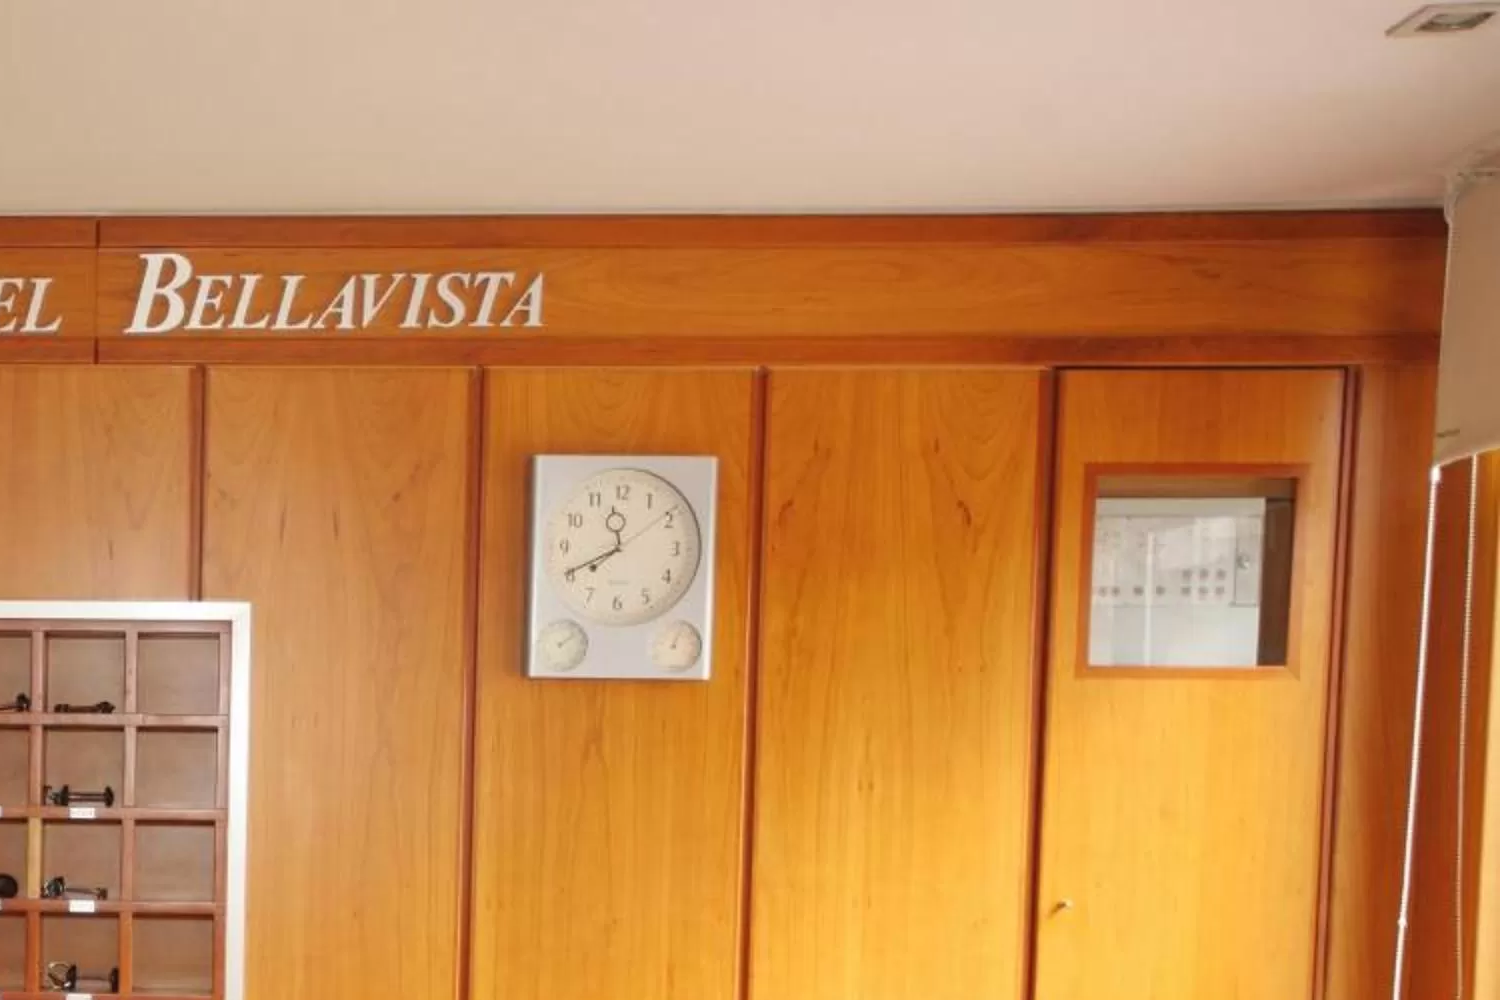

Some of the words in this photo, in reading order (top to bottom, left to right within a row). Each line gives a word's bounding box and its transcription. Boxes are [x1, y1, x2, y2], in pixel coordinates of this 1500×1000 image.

[122, 252, 545, 335] BELLAVISTA
[588, 492, 602, 508] 11
[616, 485, 631, 501] 12
[645, 493, 655, 510] 1
[567, 513, 583, 529] 10
[663, 511, 674, 529] 2
[559, 540, 569, 556] 9
[671, 541, 680, 557] 3
[661, 569, 672, 585] 4
[584, 587, 595, 603] 7
[640, 588, 650, 605] 5
[612, 597, 623, 611] 6
